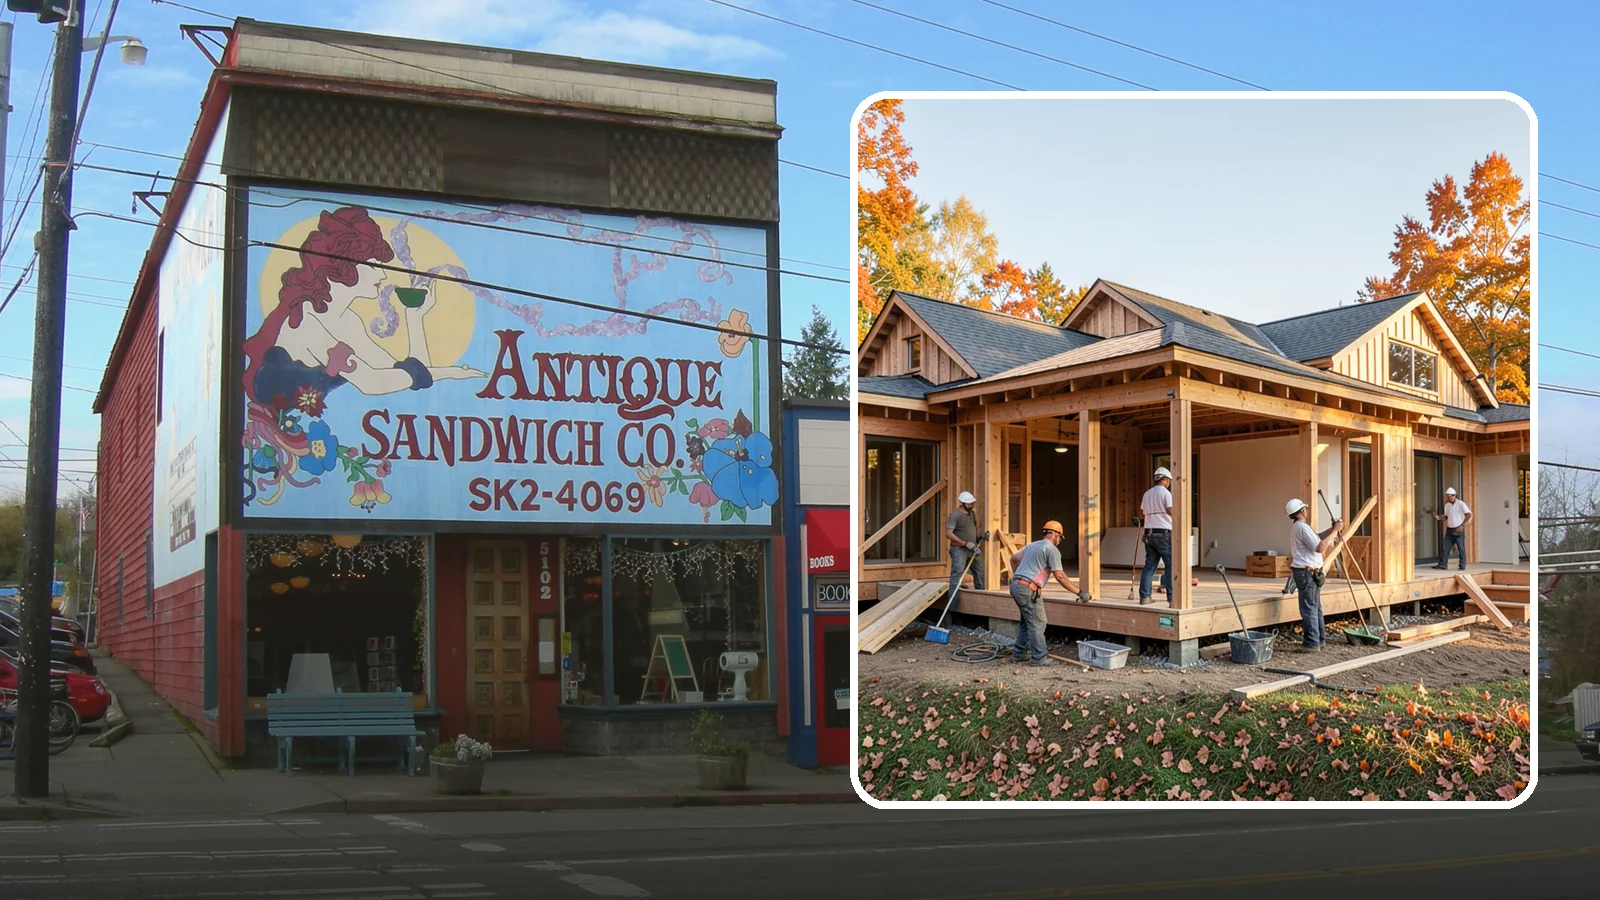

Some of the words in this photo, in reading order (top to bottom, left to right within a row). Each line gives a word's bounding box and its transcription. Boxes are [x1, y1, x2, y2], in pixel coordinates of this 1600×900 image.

[361, 409, 604, 467] SANDWICH
[617, 422, 685, 470] CO.
[468, 477, 646, 513] SK2-4069
[539, 541, 552, 600] 5102
[809, 555, 835, 569] BOOKS
